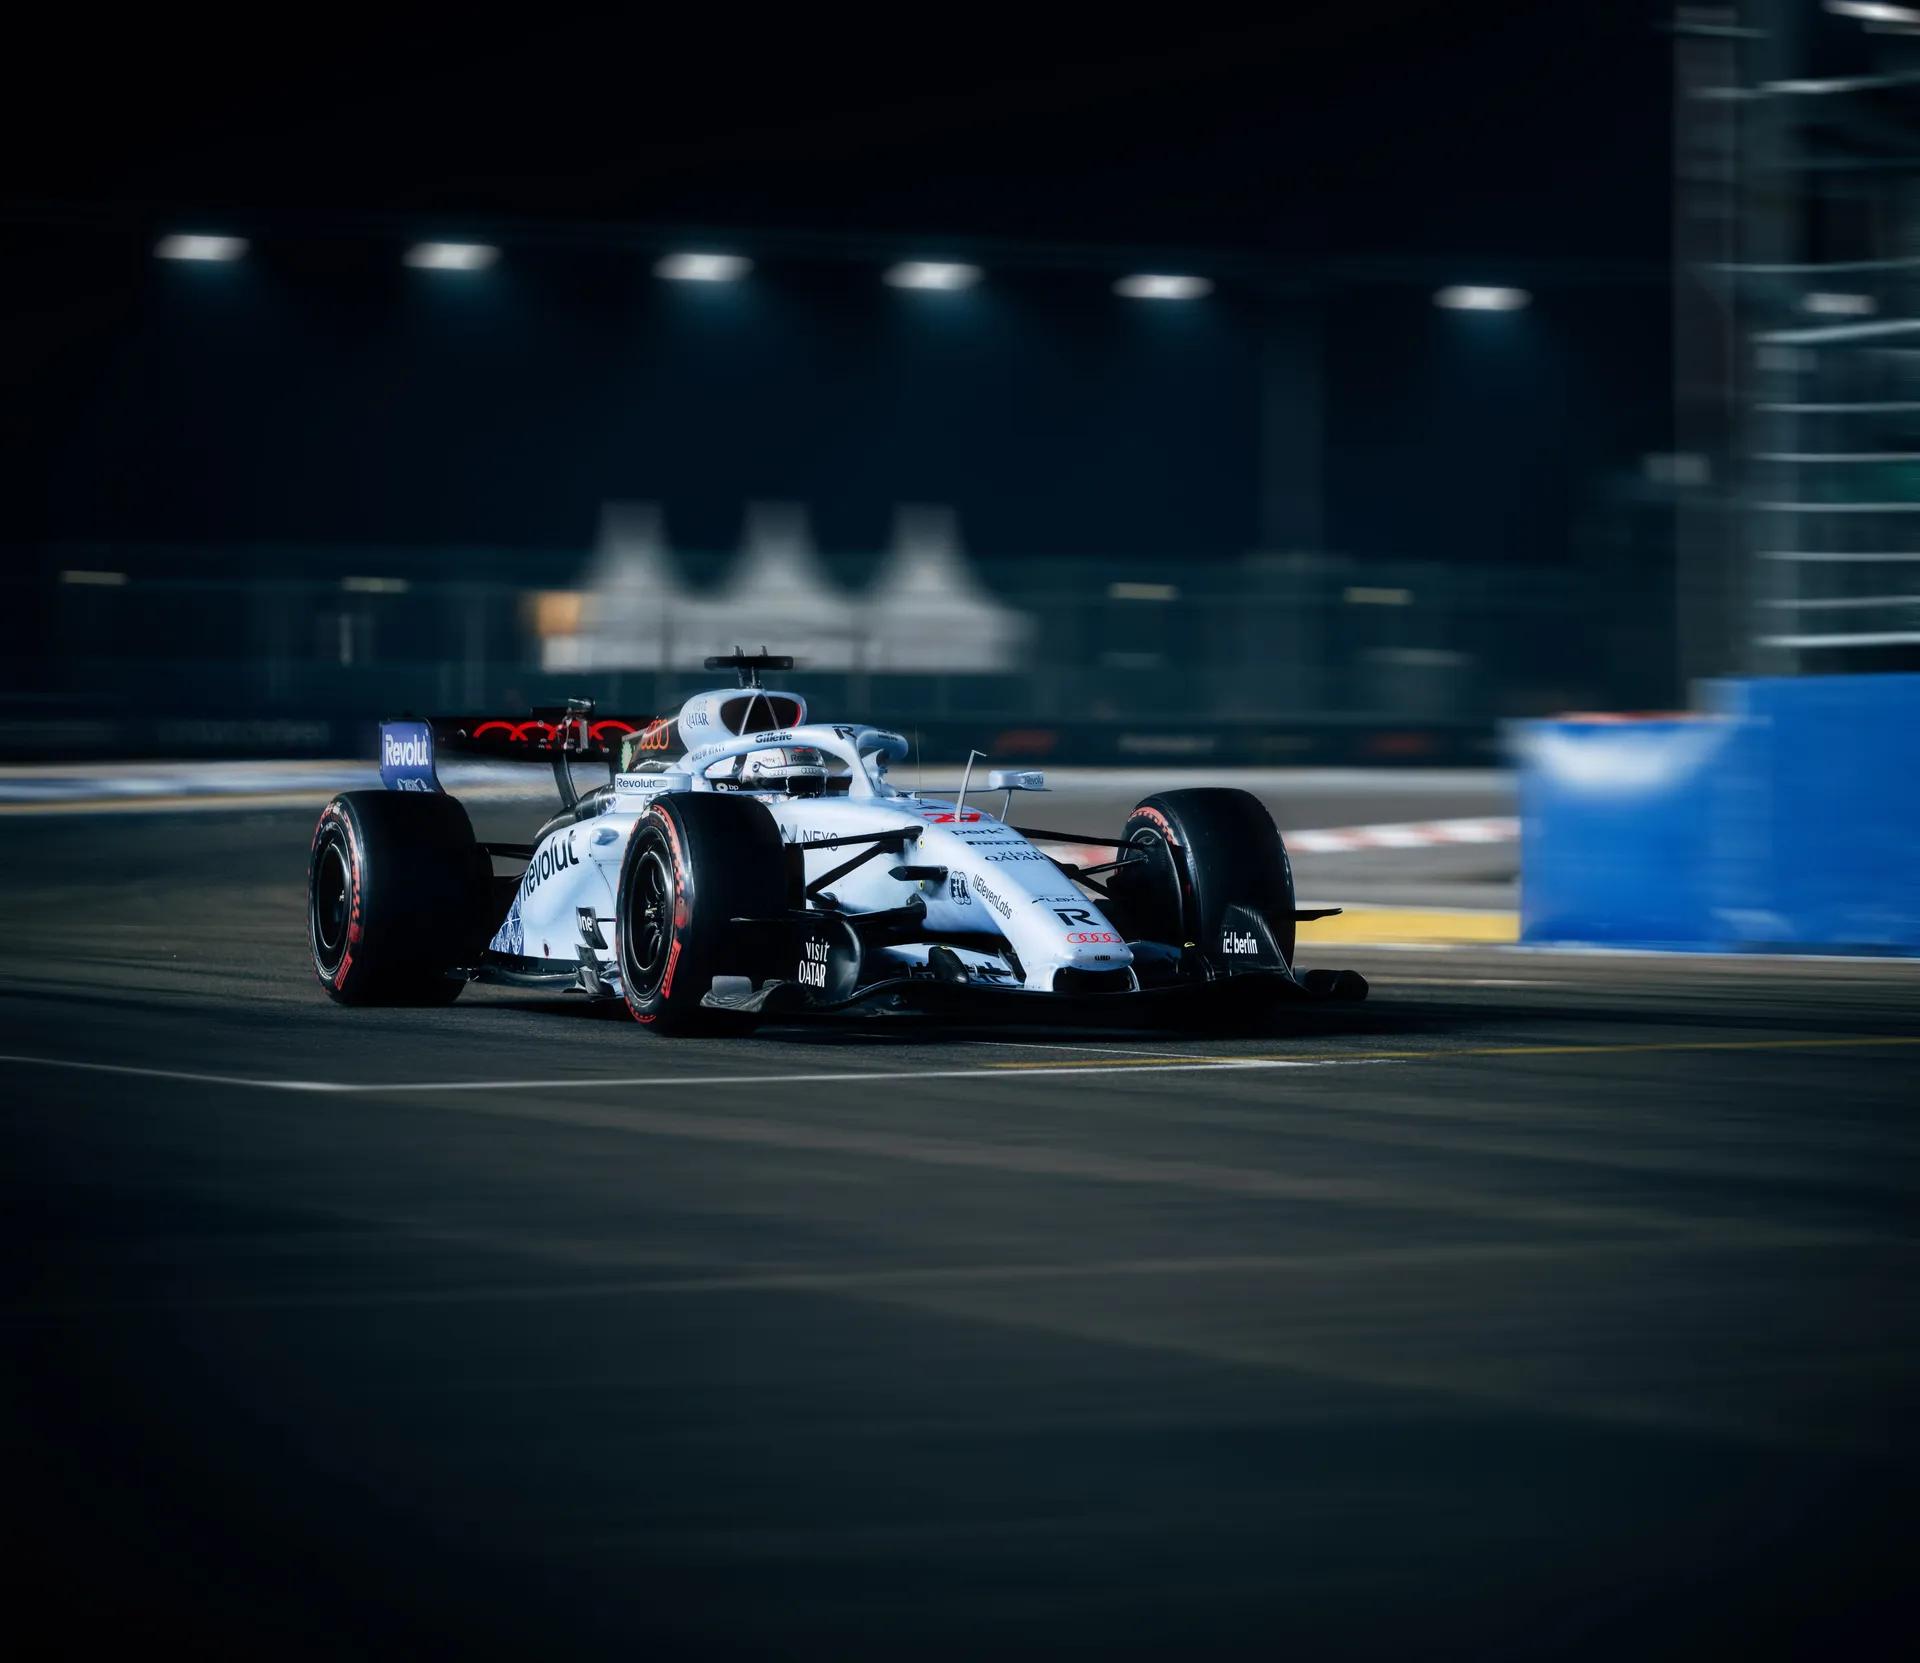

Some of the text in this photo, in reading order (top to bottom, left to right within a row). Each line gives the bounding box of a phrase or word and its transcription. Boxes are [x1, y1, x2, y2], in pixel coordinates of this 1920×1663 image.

[755, 731, 793, 744] Gillette
[385, 733, 429, 766] Revolut
[790, 754, 818, 762] Revolu
[616, 777, 654, 788] Revolut
[1025, 774, 1044, 785] Revolu
[1053, 908, 1101, 926] R
[805, 935, 831, 963] visit
[1233, 931, 1259, 955] berlin
[798, 959, 827, 988] QATAR
